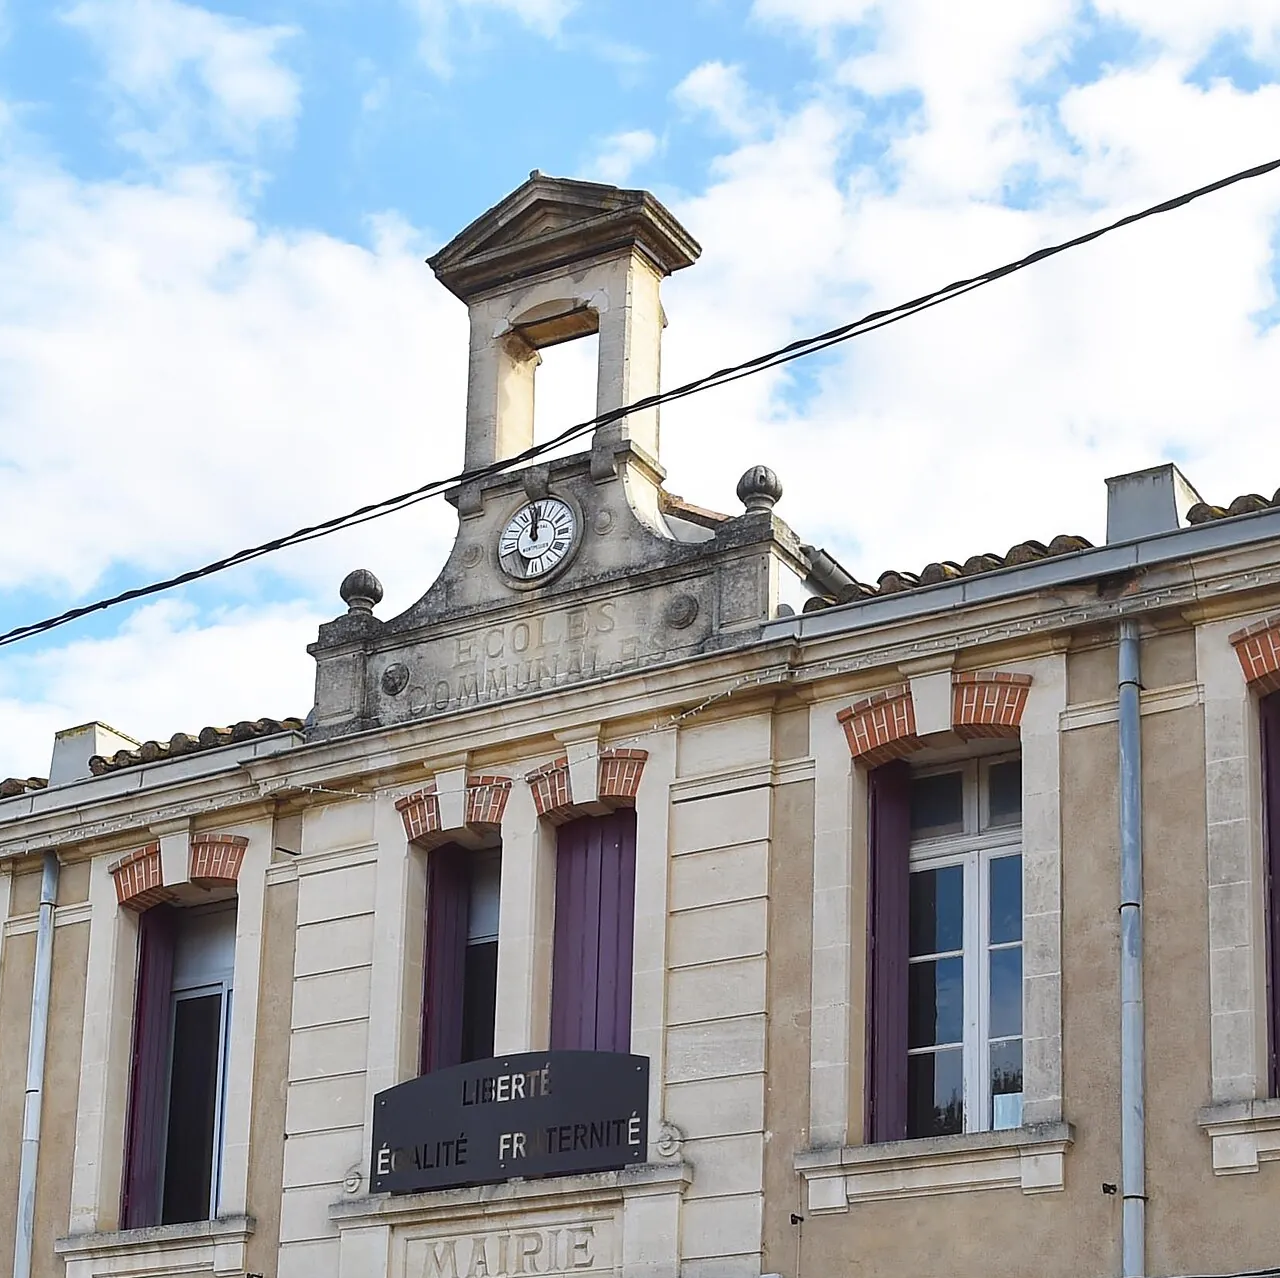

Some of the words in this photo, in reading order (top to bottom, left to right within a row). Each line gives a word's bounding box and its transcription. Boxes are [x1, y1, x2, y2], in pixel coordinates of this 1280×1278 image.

[451, 602, 616, 669] ECOLES
[462, 1062, 552, 1106] LIBERTÉ
[499, 1110, 641, 1161] FRTERNITÉ
